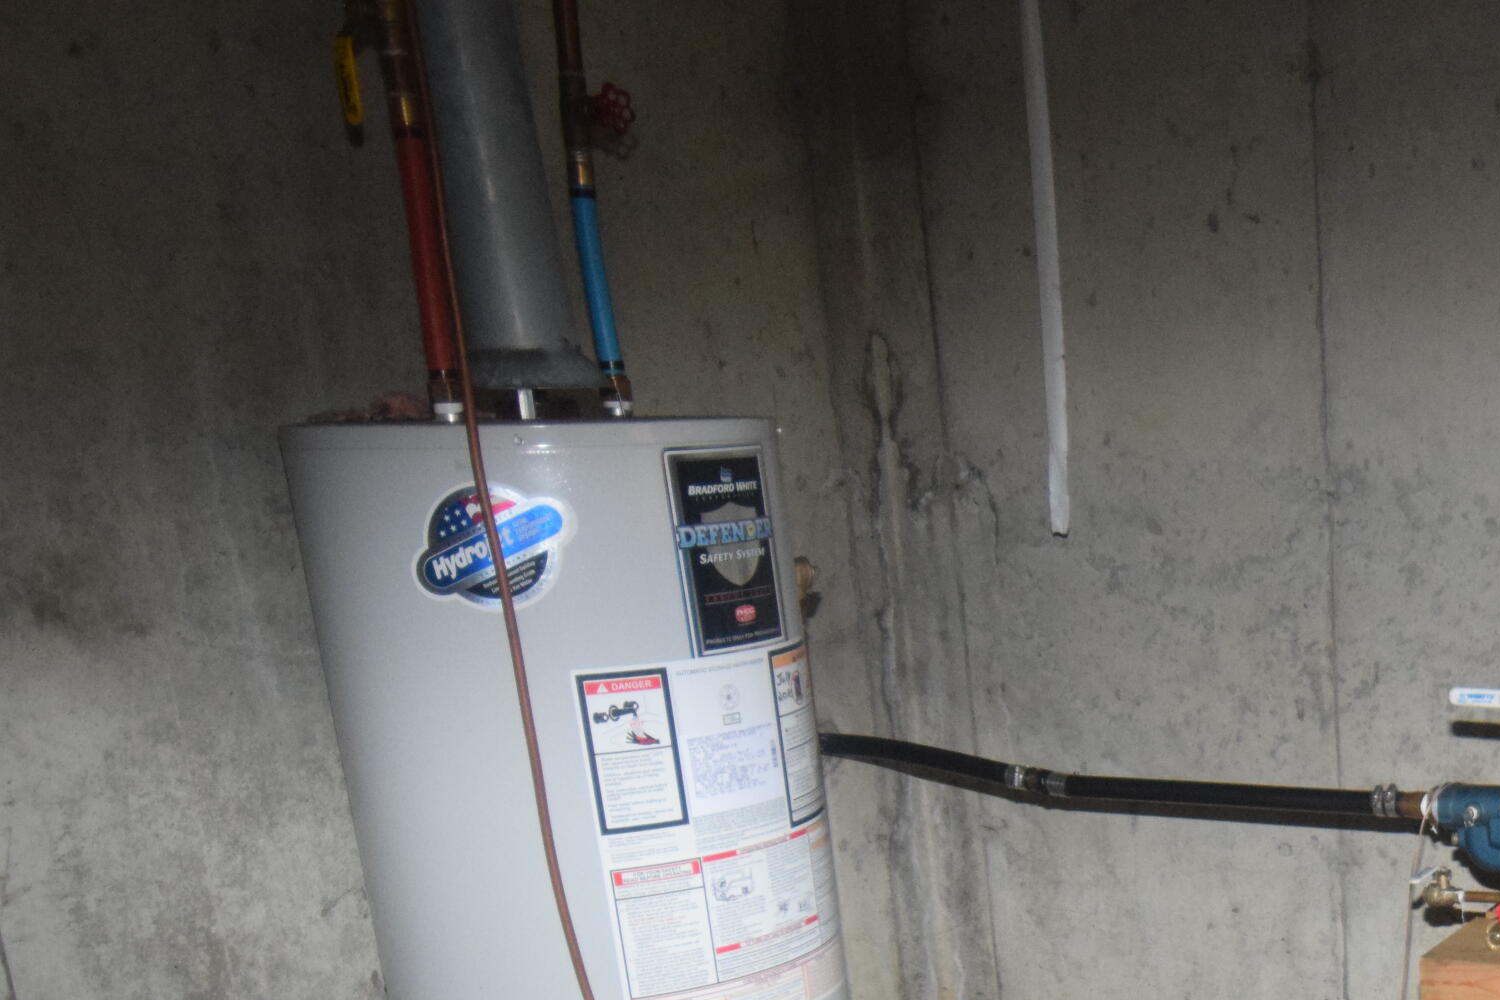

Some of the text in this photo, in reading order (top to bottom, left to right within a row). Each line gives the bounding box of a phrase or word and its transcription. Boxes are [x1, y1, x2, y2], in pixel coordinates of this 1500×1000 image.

[688, 480, 758, 496] BRADFORD WHITE
[677, 517, 773, 549] DEFENDER
[699, 551, 734, 565] SAFETY
[611, 679, 652, 691] DANGER
